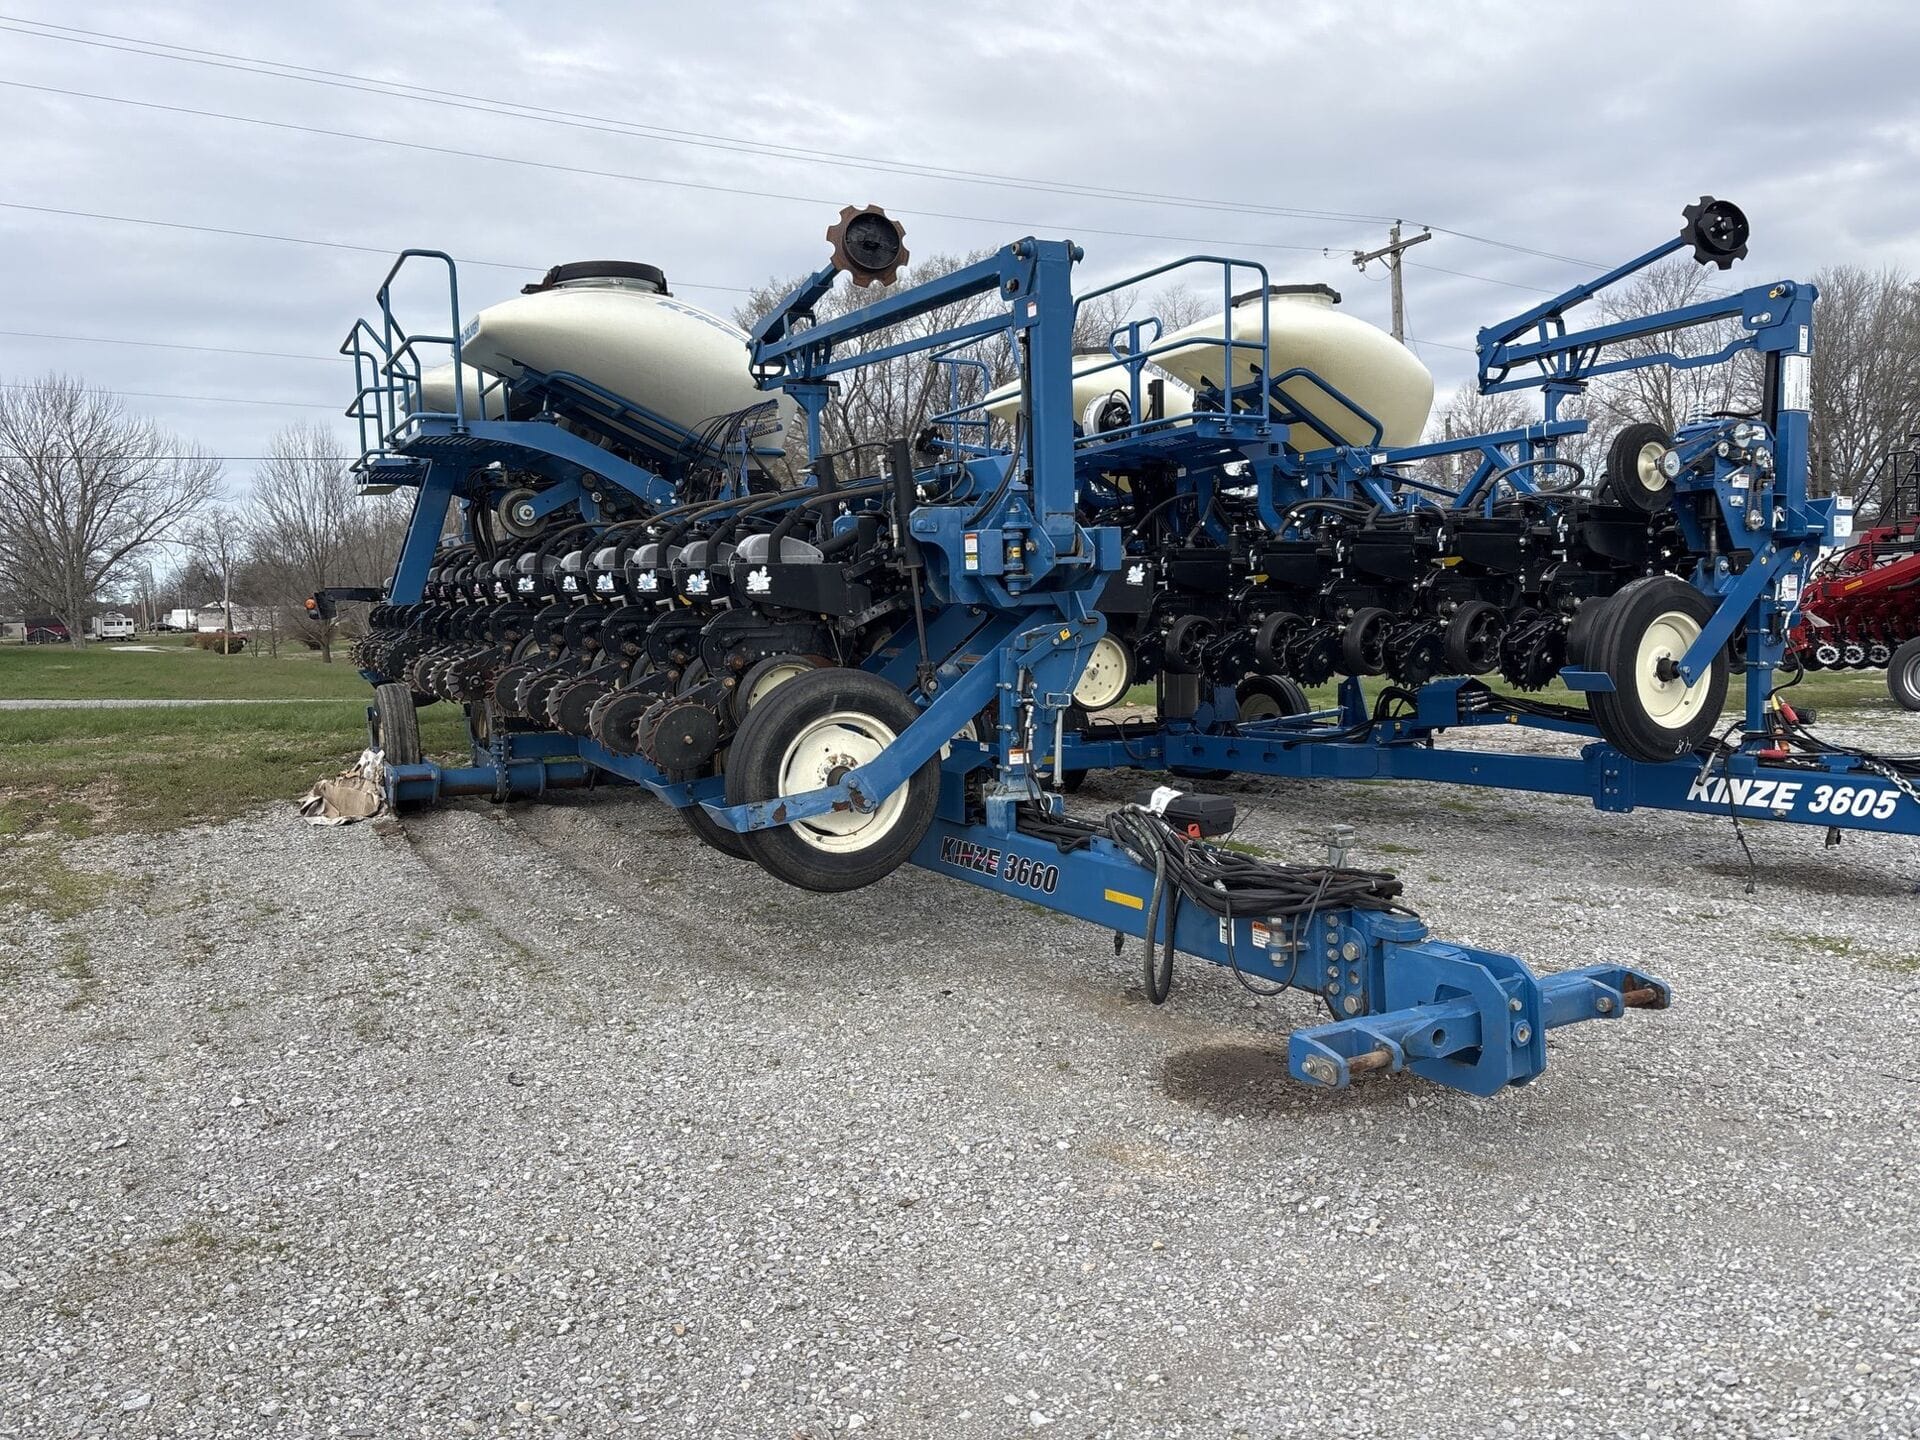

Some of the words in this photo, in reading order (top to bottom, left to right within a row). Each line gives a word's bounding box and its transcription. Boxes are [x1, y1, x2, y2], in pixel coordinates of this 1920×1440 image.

[1686, 776, 1803, 811] KINZE
[1808, 785, 1902, 819] 3605
[940, 836, 1002, 878] KINZE
[1003, 853, 1060, 895] 3660
